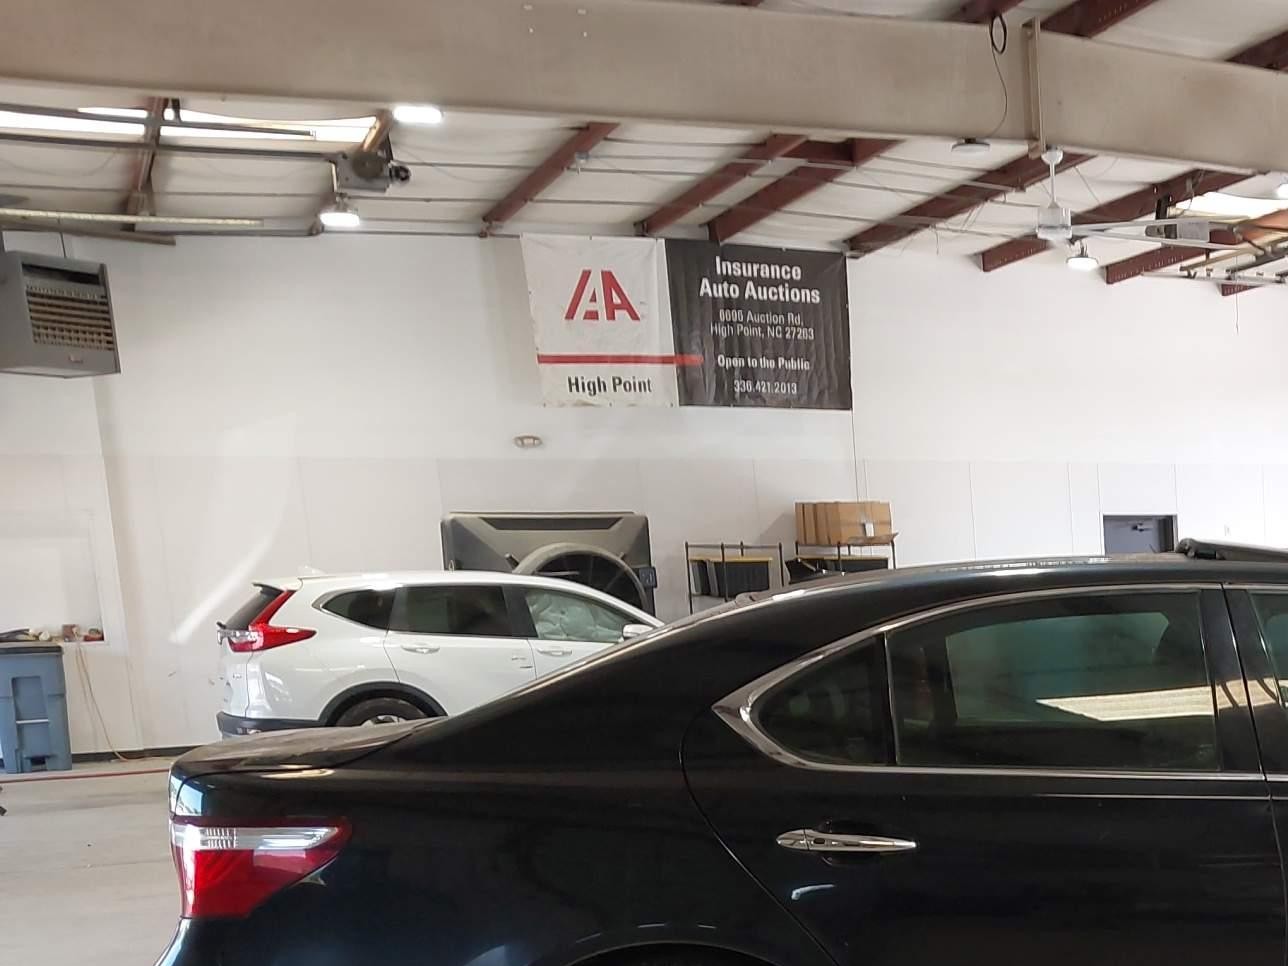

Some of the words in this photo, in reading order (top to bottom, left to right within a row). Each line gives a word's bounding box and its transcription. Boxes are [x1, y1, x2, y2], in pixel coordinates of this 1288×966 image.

[715, 255, 802, 280] Insurance
[699, 277, 740, 299] Auto
[744, 280, 821, 304] Auctions
[746, 310, 785, 325] Auction
[710, 321, 734, 339] High
[767, 325, 782, 338] NC
[717, 354, 745, 371] Open
[747, 356, 758, 369] to
[760, 355, 776, 369] the
[777, 356, 811, 371] Public
[567, 375, 607, 397] High
[611, 375, 653, 393] Point
